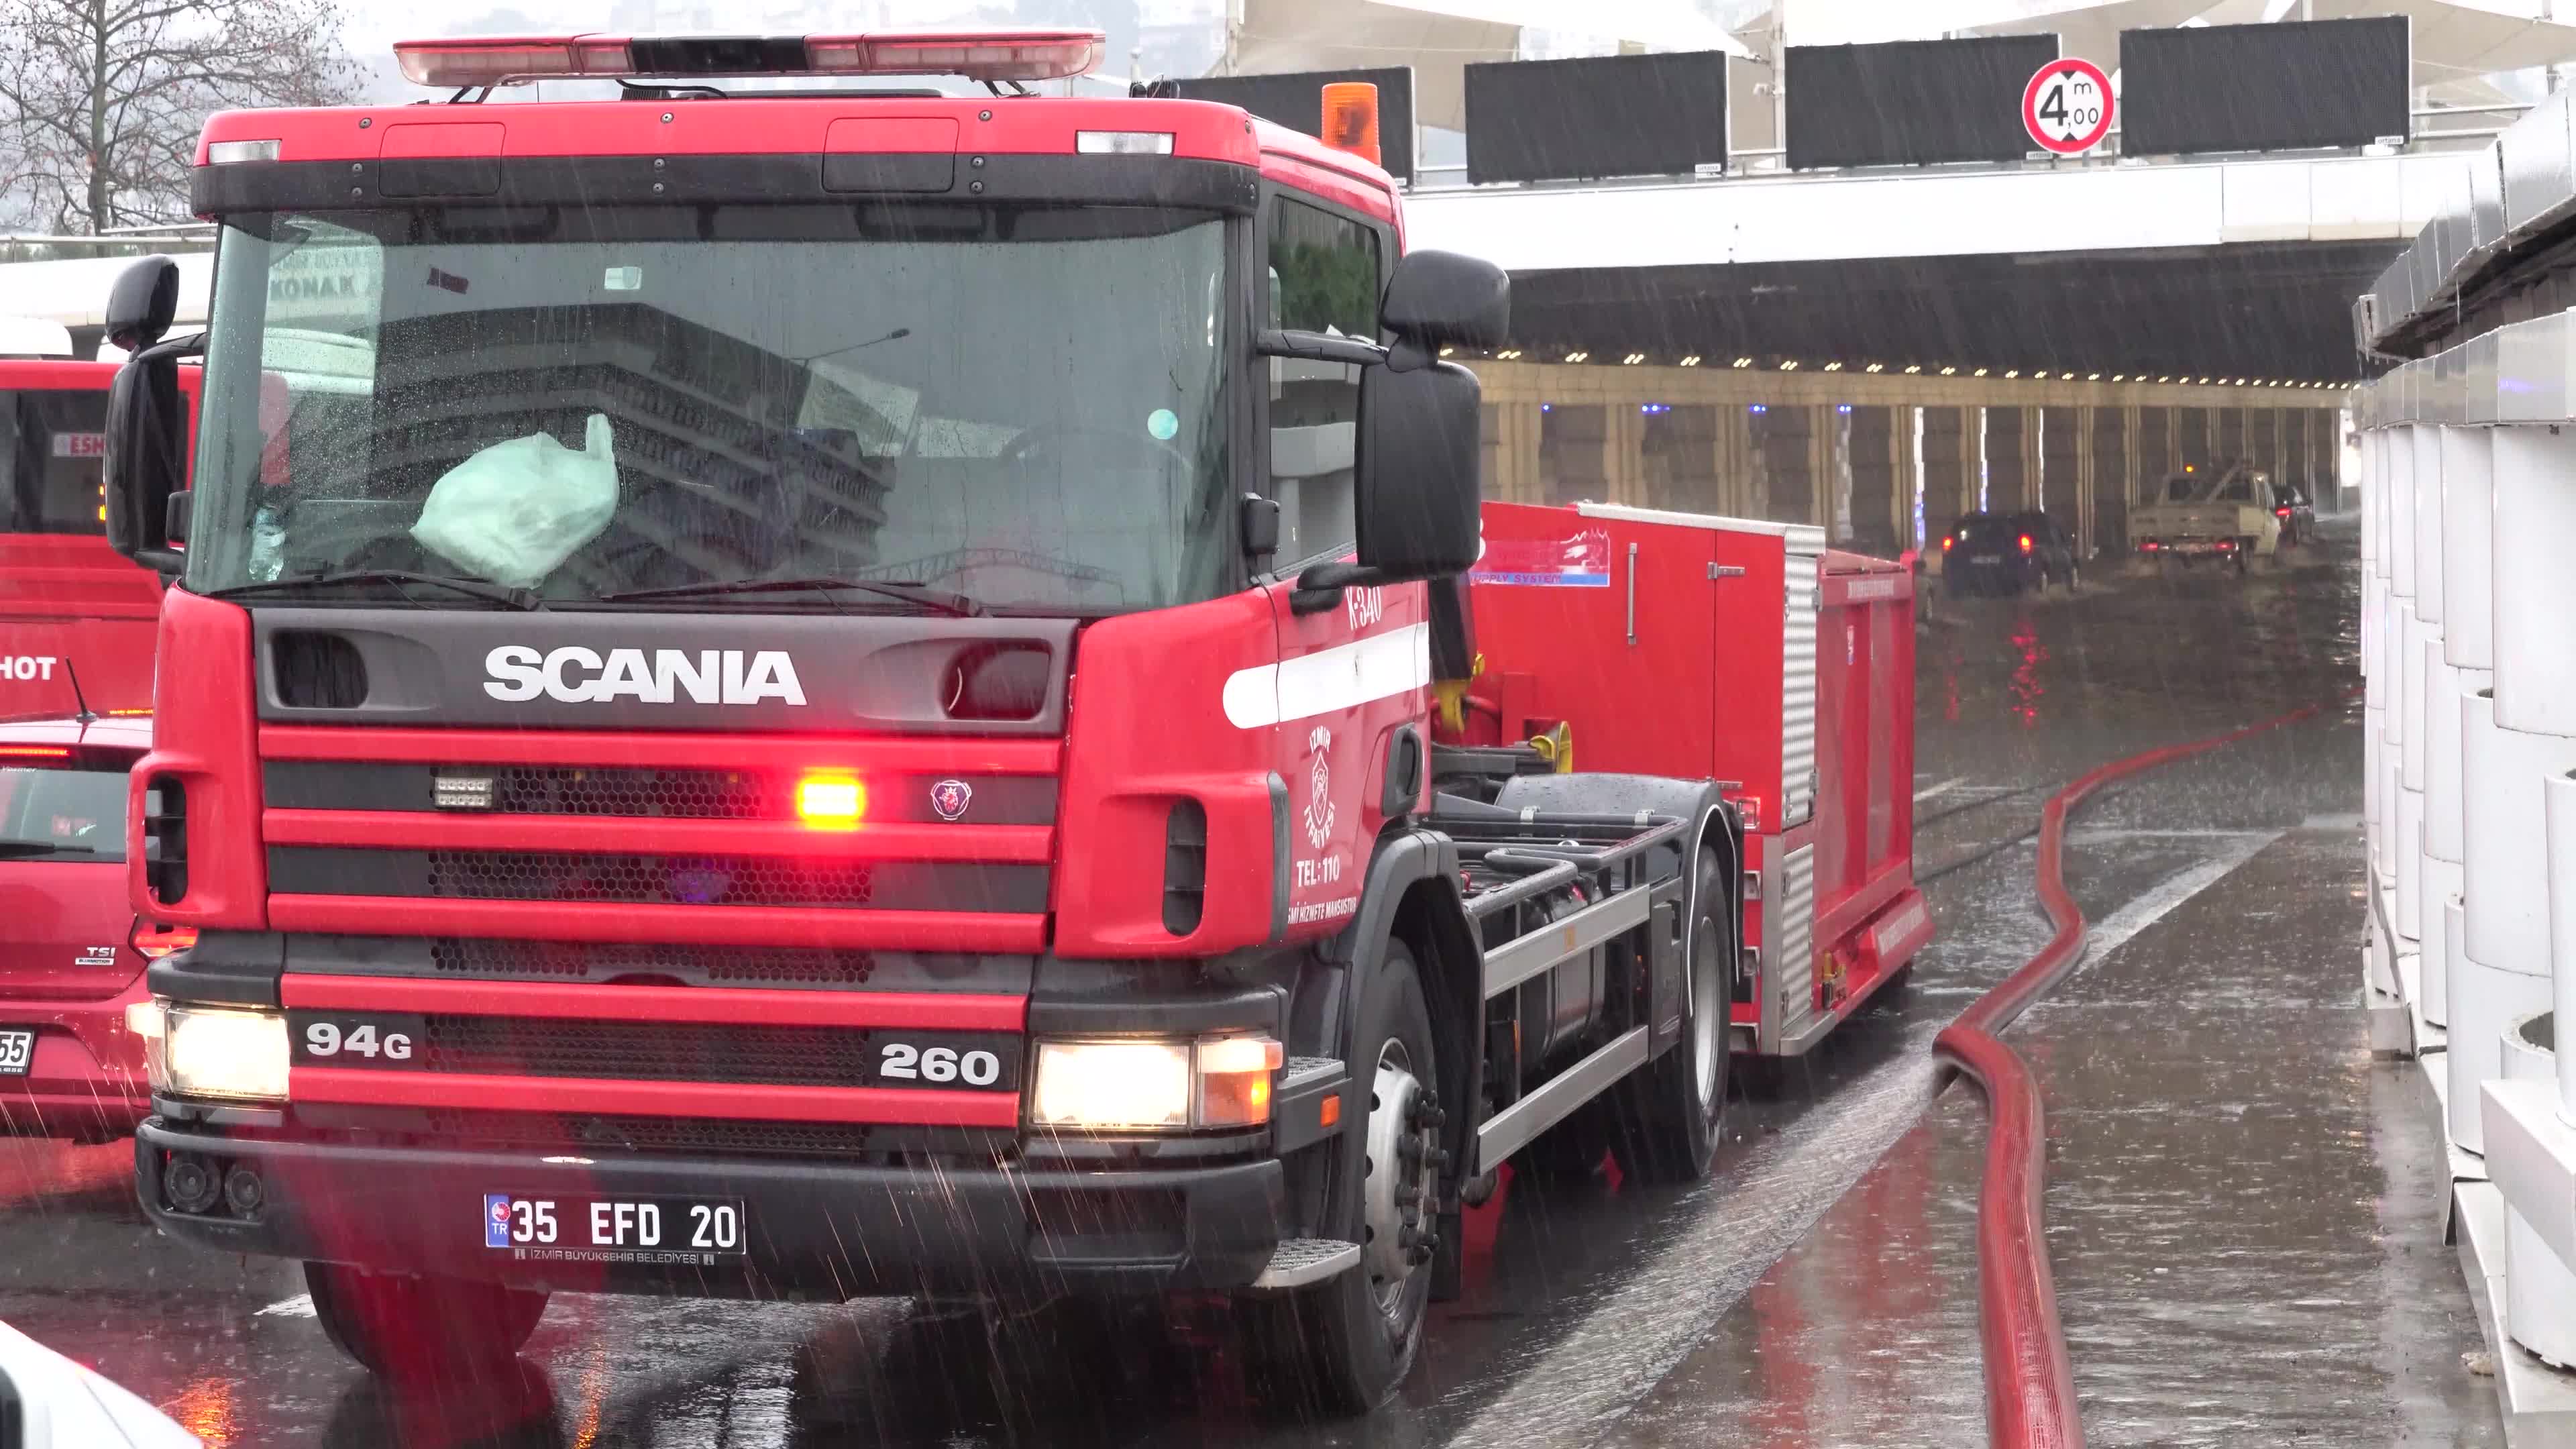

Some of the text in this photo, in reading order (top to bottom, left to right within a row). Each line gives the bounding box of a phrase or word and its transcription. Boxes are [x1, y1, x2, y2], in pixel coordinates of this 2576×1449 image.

[0, 655, 57, 681] HOT
[483, 645, 808, 706] SCANIA
[87, 947, 116, 957] TSI
[880, 1043, 1000, 1085] 260
[492, 1223, 508, 1235] TR
[512, 1201, 737, 1248] 35 EFD 20
